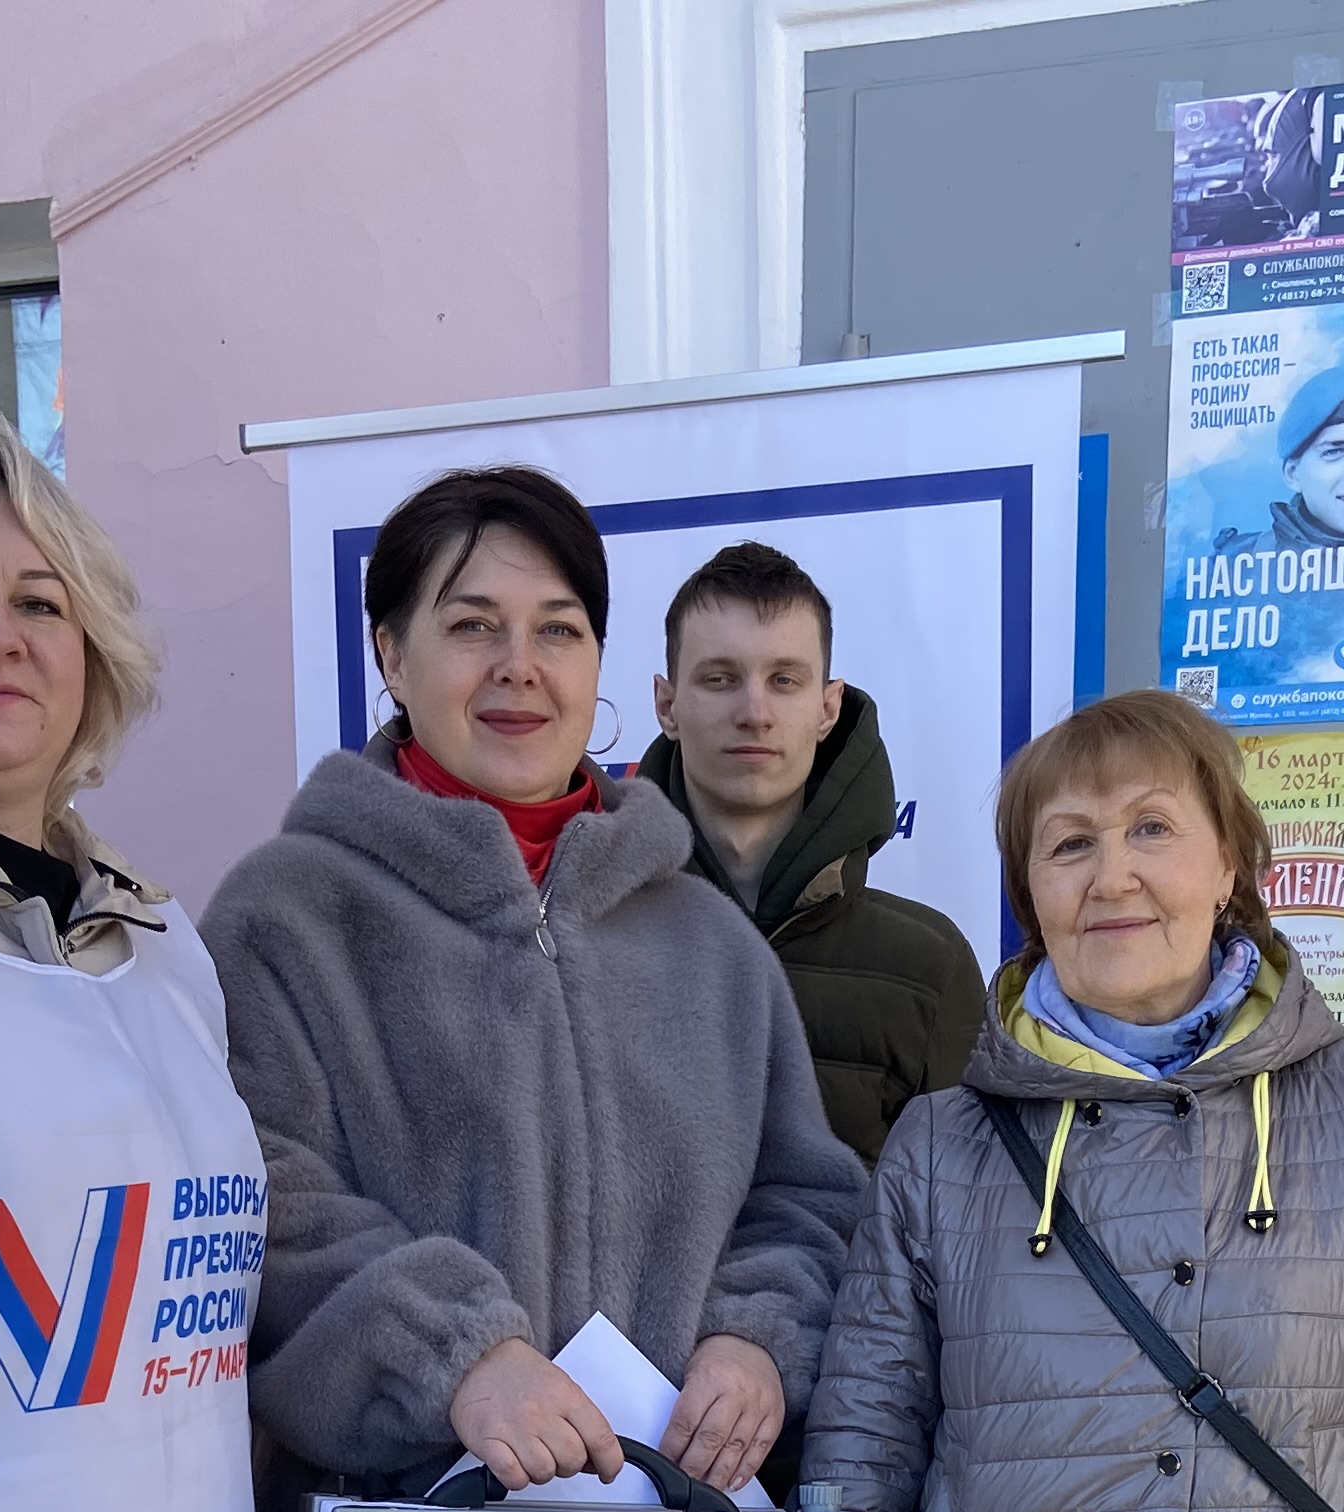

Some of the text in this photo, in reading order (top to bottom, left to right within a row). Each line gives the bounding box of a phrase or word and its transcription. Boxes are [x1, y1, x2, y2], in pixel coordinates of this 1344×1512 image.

[1315, 238, 1334, 248] СВО
[1319, 276, 1332, 286] ул.
[1262, 292, 1275, 302] +7
[1278, 290, 1308, 303] (4812)
[1192, 333, 1279, 360] ЕСТЬ ТАКАЯ
[1192, 357, 1280, 382] ПРОФЕССИЯ
[1191, 383, 1250, 408] РОДИНУ
[1190, 404, 1276, 430] ЗАЩИЩАТЬ
[1182, 604, 1280, 658] ДЕЛО
[1256, 750, 1281, 770] 16
[1310, 798, 1320, 808] в
[1288, 934, 1321, 944] щадь
[173, 1174, 268, 1221] ВЫБОРЫ
[163, 1231, 268, 1282] ПРЕЗИЕН
[215, 1340, 248, 1383] МАР
